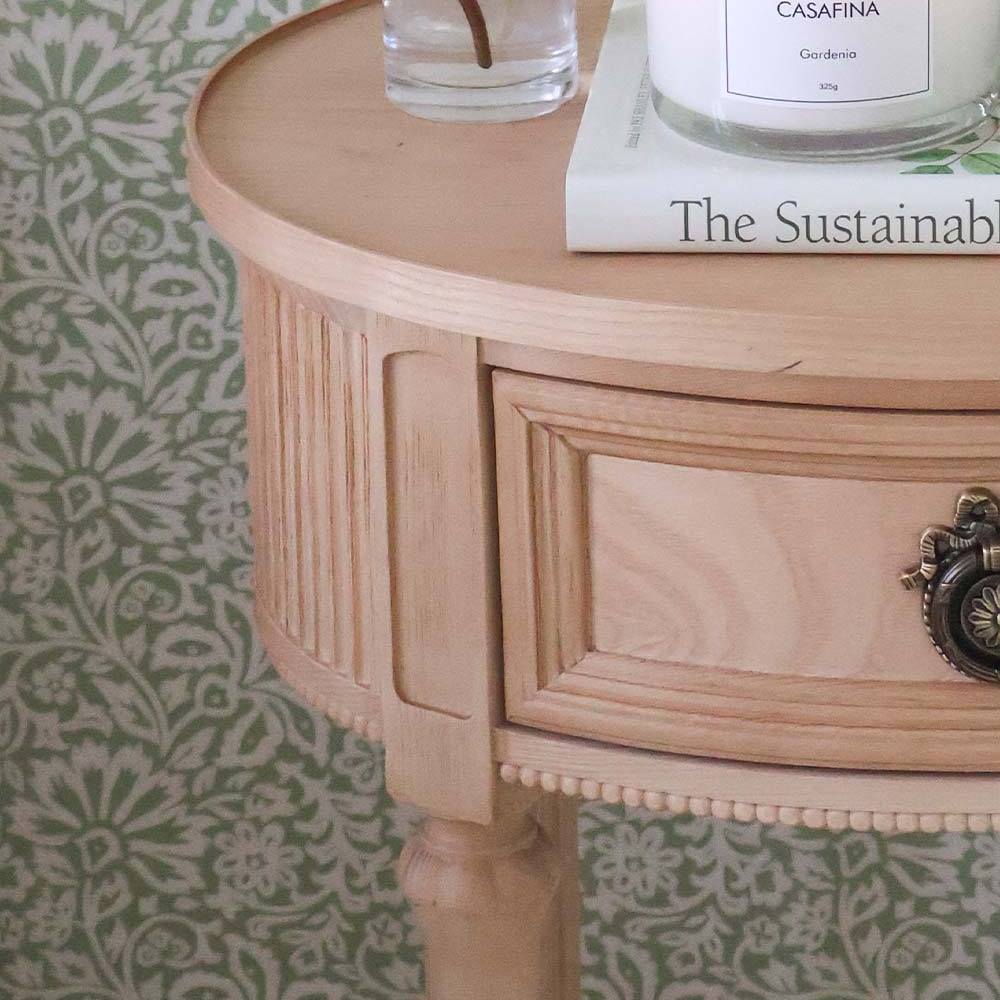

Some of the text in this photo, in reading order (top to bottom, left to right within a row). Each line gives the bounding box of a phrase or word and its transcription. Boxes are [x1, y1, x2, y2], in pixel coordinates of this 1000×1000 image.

[776, 0, 880, 19] CASAFINA
[799, 48, 857, 60] Gardenia
[818, 82, 839, 92] 325g
[670, 197, 758, 244] The
